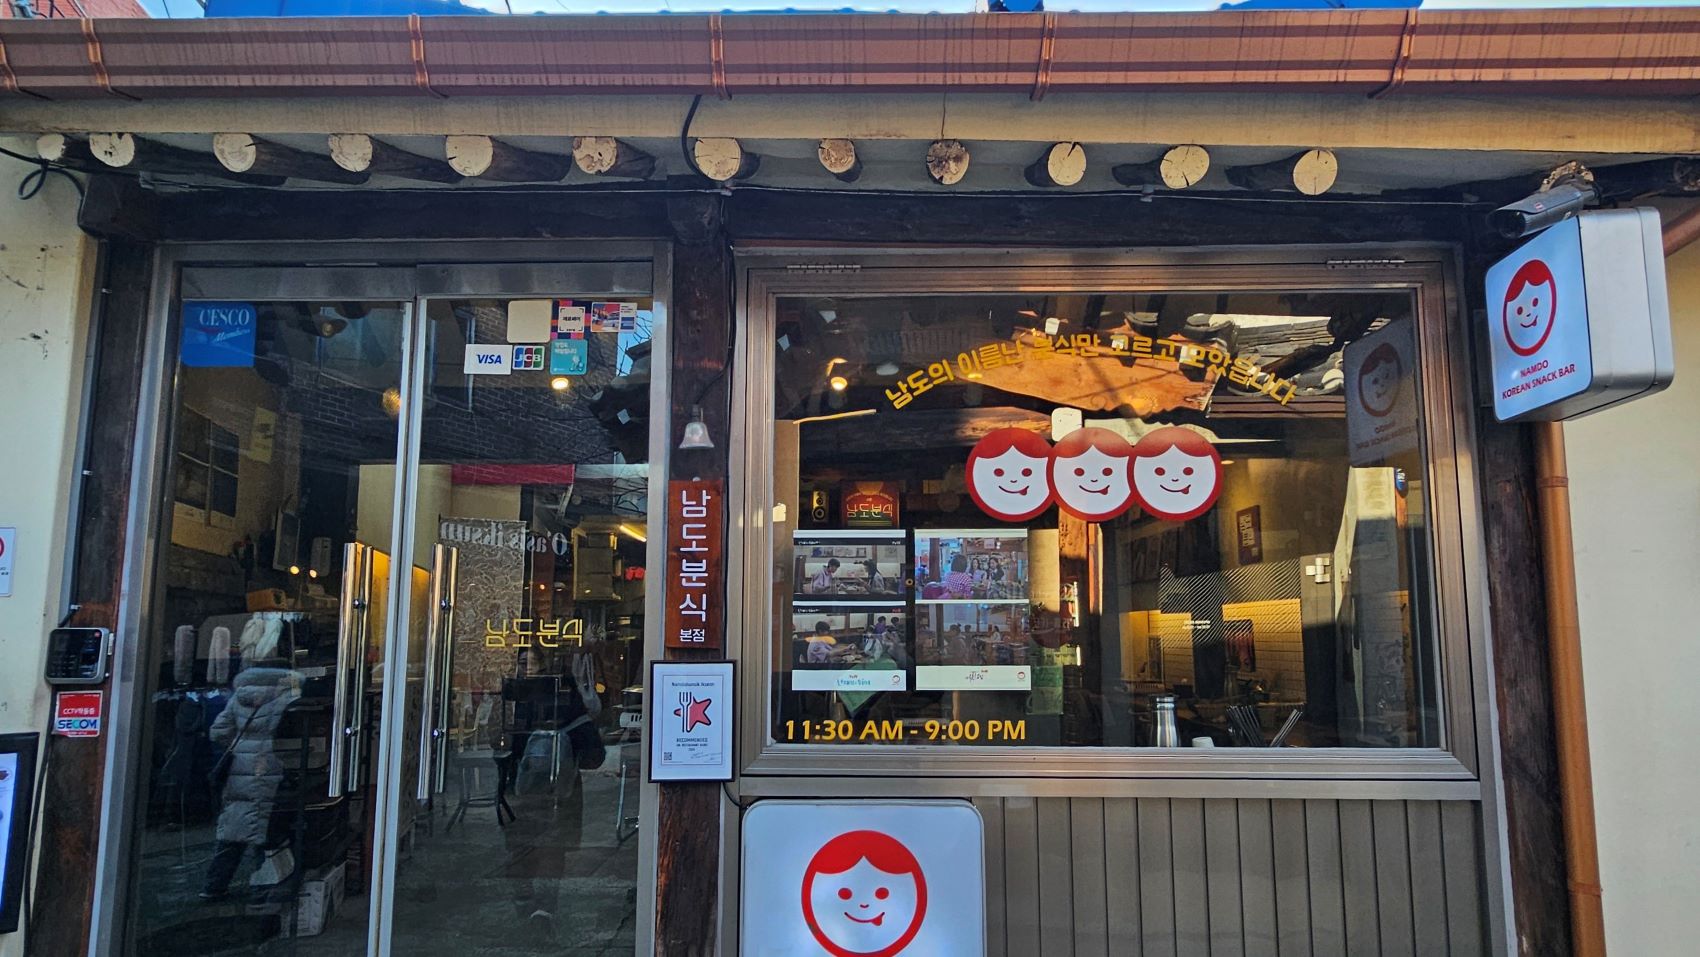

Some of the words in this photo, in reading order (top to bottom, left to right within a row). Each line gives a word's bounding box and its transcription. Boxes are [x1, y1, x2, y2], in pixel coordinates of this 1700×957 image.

[199, 308, 251, 326] CESCO
[477, 354, 502, 365] VISA
[1520, 360, 1549, 378] NAMDO
[885, 359, 955, 410] 남도의
[957, 340, 1025, 374] 이름난
[1032, 333, 1101, 360] 분식만
[1109, 334, 1178, 362] 고르고
[1179, 343, 1298, 406] 모았습니다
[1502, 382, 1532, 400] KOREAN
[1532, 370, 1558, 388] SNACK
[1558, 363, 1576, 379] BAR
[679, 489, 712, 623] 남도분식
[485, 618, 583, 648] 남도분식
[679, 628, 705, 643] 본점
[57, 719, 98, 729] SECOM
[785, 719, 854, 741] 11:30
[859, 719, 903, 740] AM
[924, 719, 980, 740] 9:00
[987, 719, 1026, 740] PM
